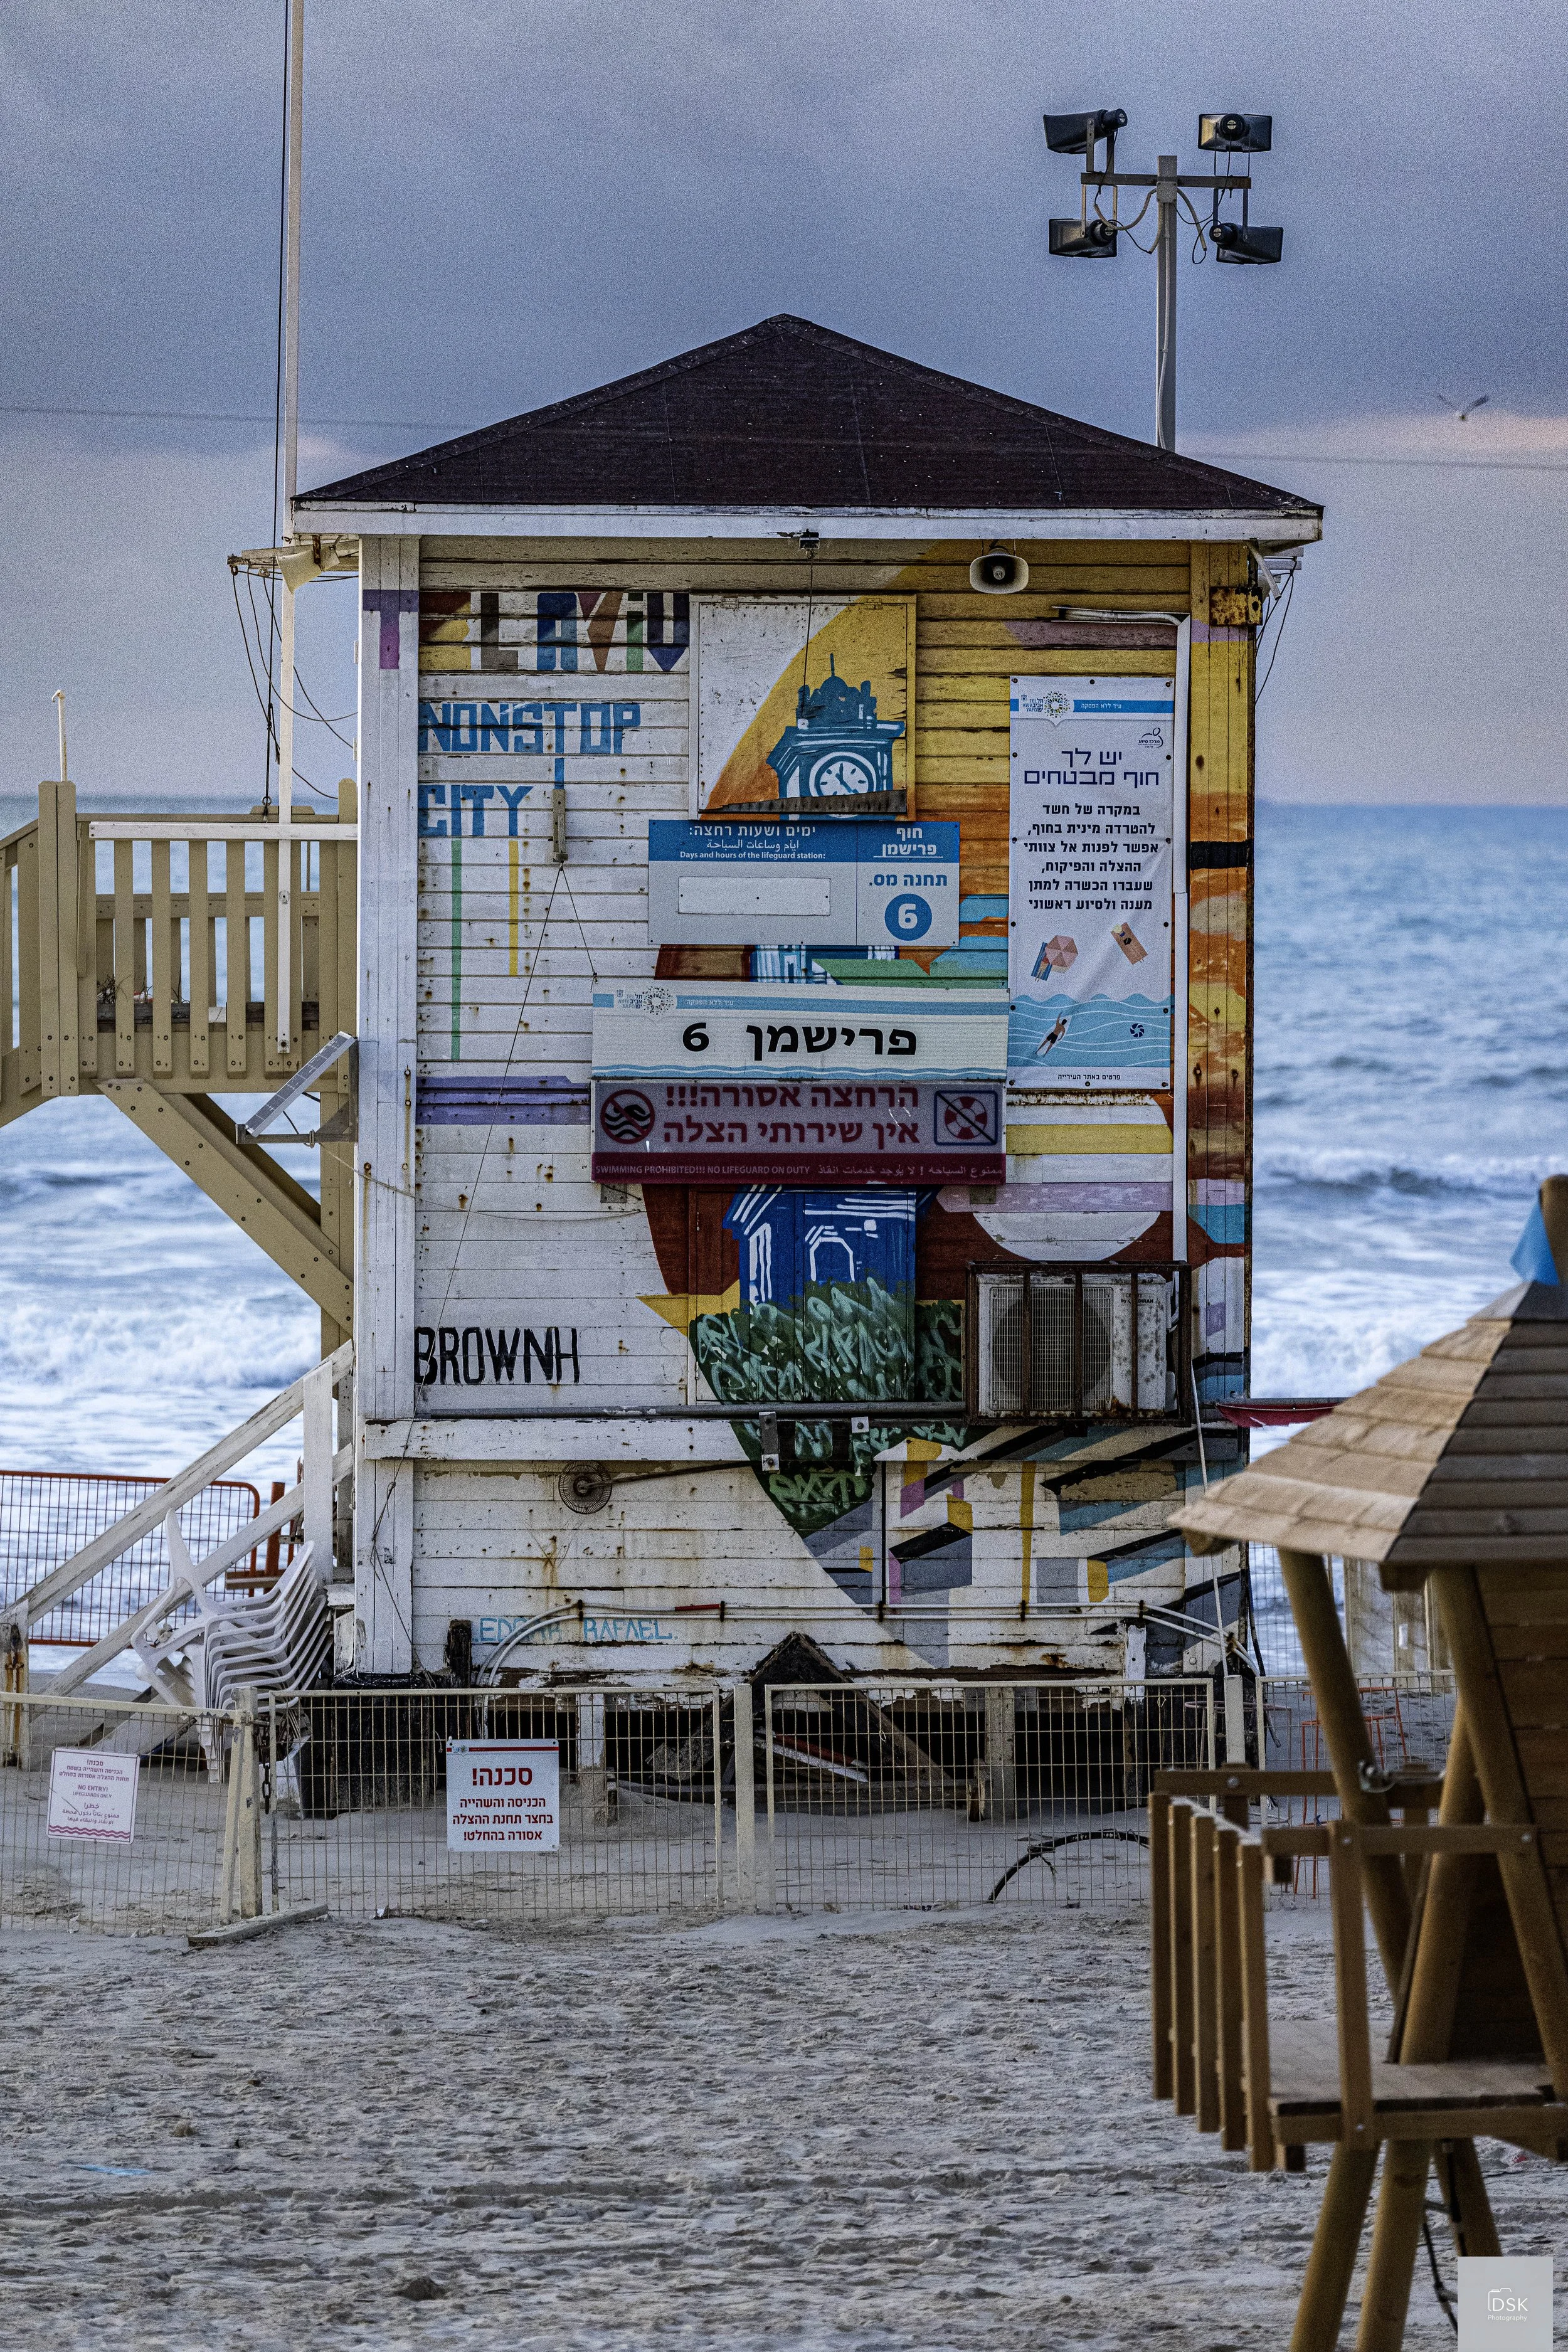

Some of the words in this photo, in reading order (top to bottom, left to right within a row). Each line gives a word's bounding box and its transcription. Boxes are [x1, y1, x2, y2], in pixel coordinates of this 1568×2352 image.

[418, 702, 640, 754] NONSTOP
[1061, 748, 1092, 768] לך
[1100, 751, 1122, 766] יש
[1024, 770, 1115, 786] מבטחים
[1124, 771, 1159, 788] חוף
[418, 784, 534, 837] CITY
[1042, 805, 1070, 815] חשד
[1075, 802, 1093, 815] של
[1098, 805, 1140, 818] במקרה
[689, 825, 733, 836] רחצה:
[738, 826, 780, 837] ושעות
[786, 826, 815, 837] ימים
[896, 827, 923, 839] חוף
[1027, 824, 1062, 836] בחוף,
[1067, 824, 1101, 834] מינית
[1105, 822, 1155, 834] להטרדה
[707, 839, 743, 850] السباحة
[746, 840, 781, 852] وساعات
[882, 844, 937, 857] פרישמן
[1024, 842, 1056, 852] צוותי
[1061, 840, 1077, 852] אל
[1081, 840, 1118, 853] לפנות
[1123, 843, 1158, 853] אפשר
[680, 851, 698, 859] Days
[1041, 861, 1095, 873] והפיקוח,
[1099, 859, 1142, 872] ההצלה
[869, 874, 898, 887] מס.
[903, 874, 948, 887] תחנה
[1029, 877, 1060, 892] למתן
[1064, 881, 1108, 891] הכשרה
[1113, 881, 1153, 891] שעברו
[1029, 899, 1071, 909] ראשוני
[1076, 898, 1116, 910] ולסיוע
[1121, 899, 1152, 910] מענה
[898, 903, 918, 930] 6
[682, 1022, 709, 1052] 6
[746, 1024, 917, 1061] פרישמן
[666, 1085, 802, 1107] אסורה!!!
[810, 1086, 919, 1108] הרחצה
[663, 1114, 748, 1143] הצלה
[757, 1121, 863, 1144] שירותי
[872, 1122, 920, 1150] אין
[596, 1165, 642, 1174] SWIMMING
[644, 1165, 706, 1174] PROHIBITED!!!
[707, 1165, 721, 1174] NO
[722, 1165, 770, 1174] LIFEGUARD
[771, 1165, 785, 1174] ON
[787, 1165, 810, 1174] DUTY
[842, 1165, 876, 1175] خدمات
[908, 1165, 915, 1175] لا
[970, 1167, 1002, 1178] ممنوع
[414, 1327, 580, 1386] BROWNH
[472, 1767, 532, 1786] סכנה!
[460, 1798, 505, 1808] והשהייה
[507, 1798, 546, 1808] הכניסה
[452, 1813, 490, 1825] ההצלה
[492, 1814, 522, 1825] תחנת
[524, 1814, 554, 1824] בחצר
[464, 1830, 506, 1841] בהחלט!
[508, 1831, 543, 1841] אסורה
